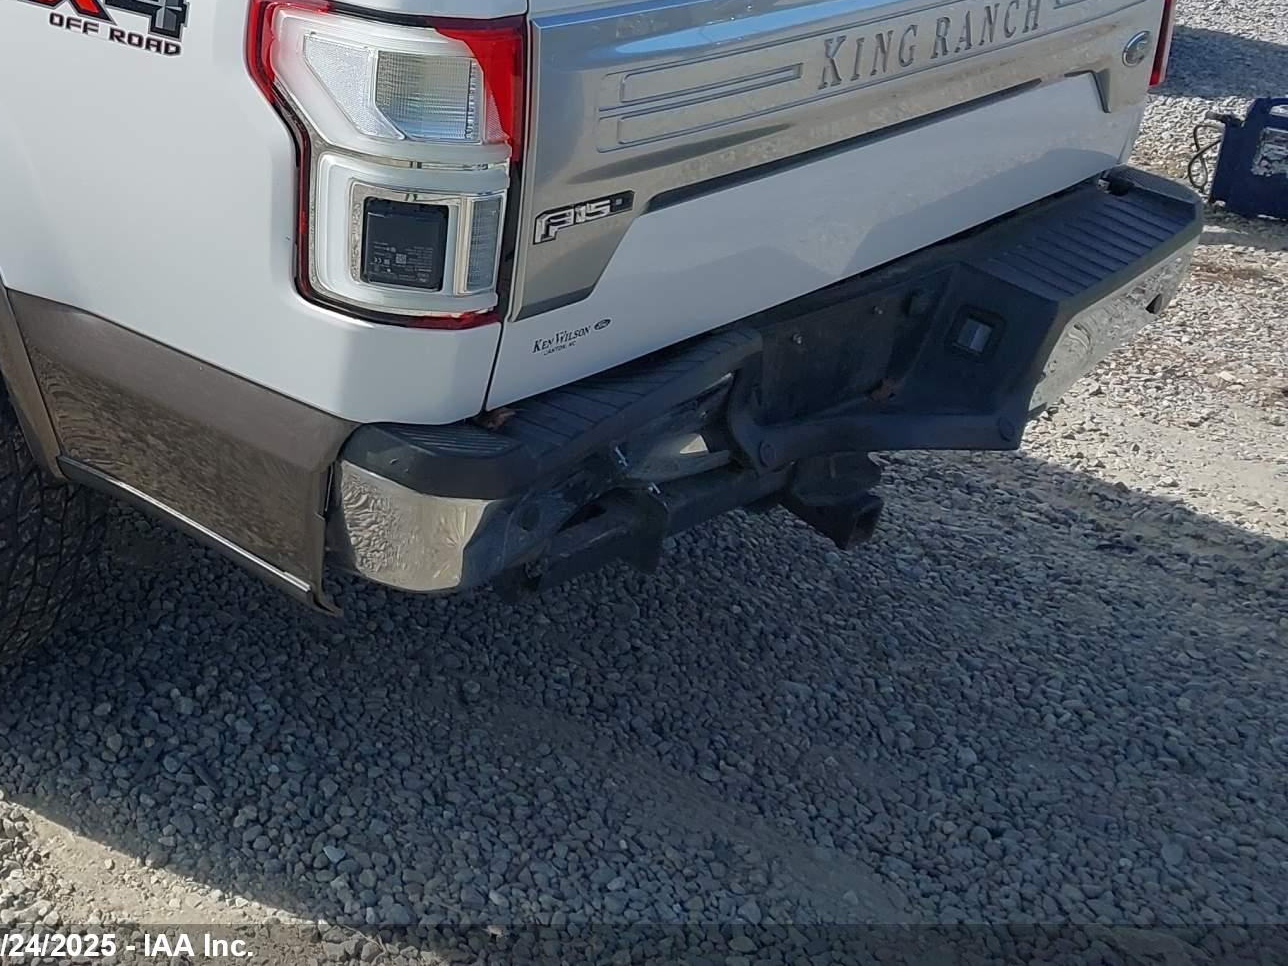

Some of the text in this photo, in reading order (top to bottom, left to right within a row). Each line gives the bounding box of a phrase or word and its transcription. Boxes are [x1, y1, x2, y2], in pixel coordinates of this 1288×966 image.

[49, 11, 182, 56] OFF ROAD
[817, 30, 919, 90] KING
[555, 325, 591, 345] WILSON
